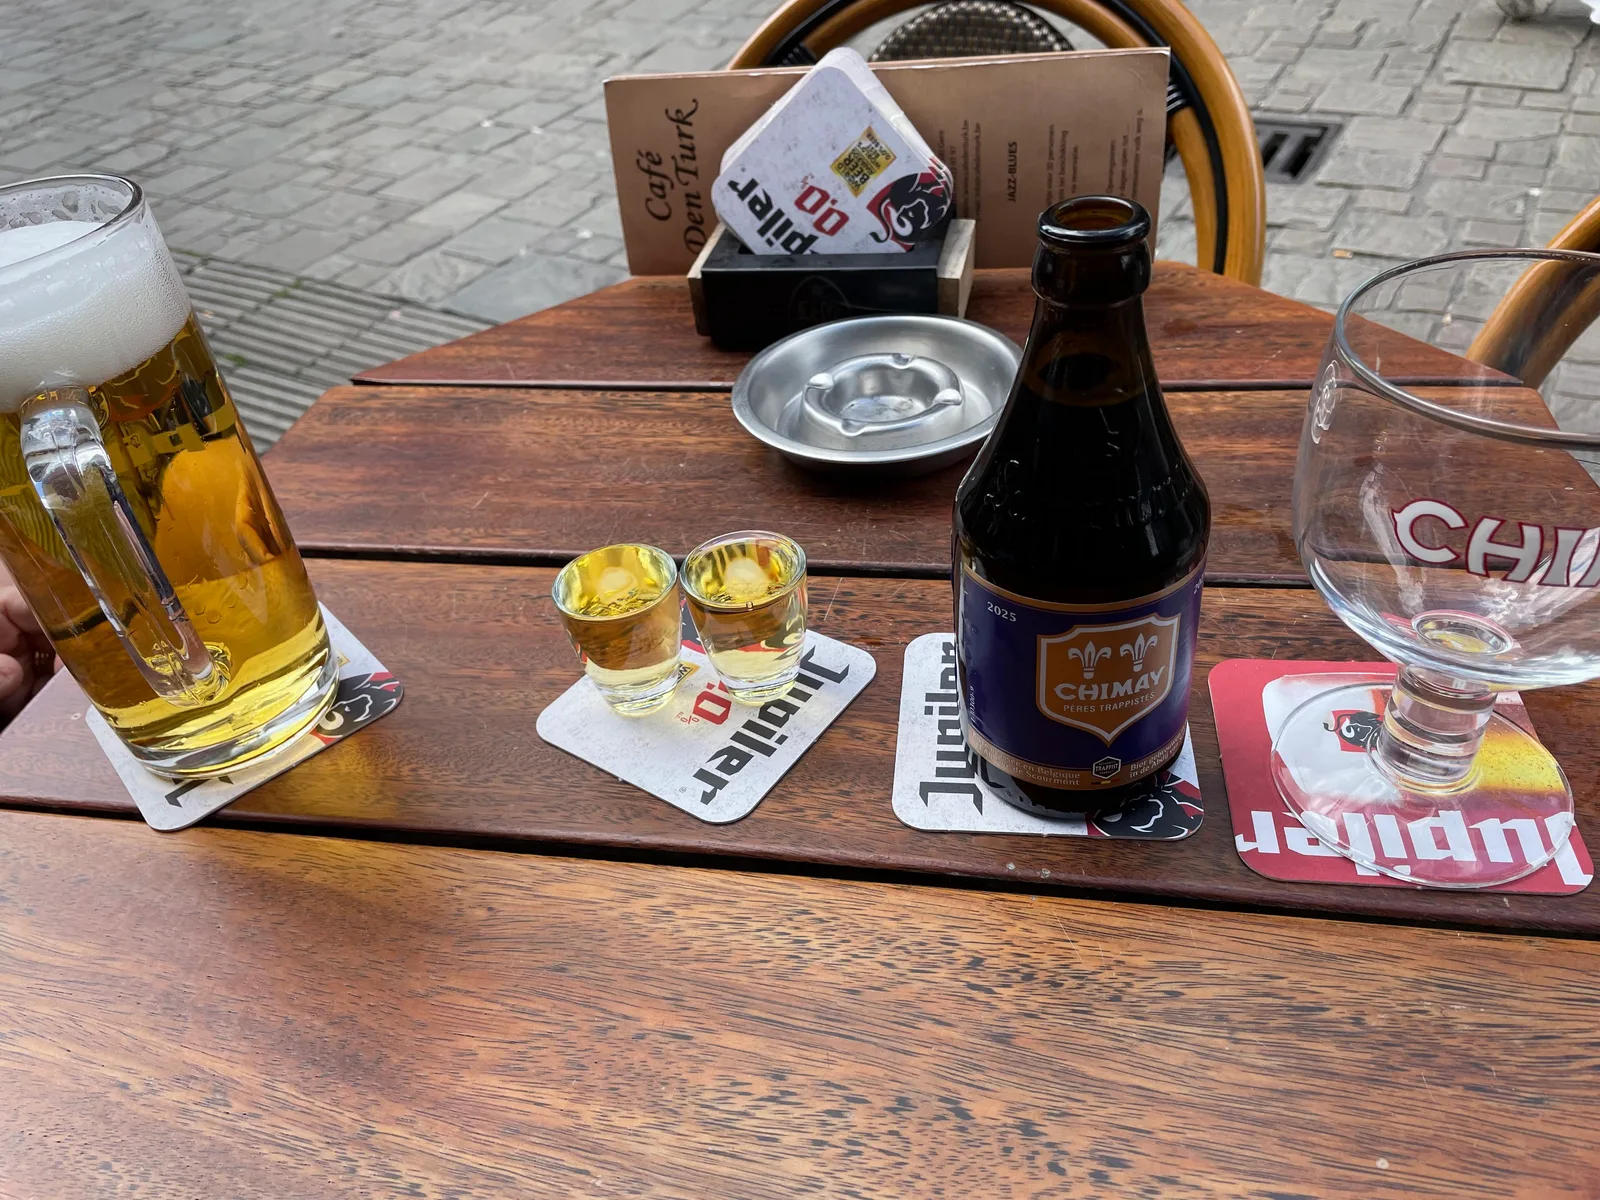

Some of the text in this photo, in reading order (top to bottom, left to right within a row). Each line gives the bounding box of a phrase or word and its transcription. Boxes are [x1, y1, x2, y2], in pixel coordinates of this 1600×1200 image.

[636, 149, 674, 222] Café
[665, 98, 708, 255] Den Turk
[843, 157, 870, 184] BEER
[1007, 141, 1018, 203] JAZZ-BLUES
[728, 178, 820, 255] piler
[1391, 498, 1600, 588] CHI
[987, 601, 1018, 622] 2025
[1053, 665, 1165, 701] CHIMAY
[1063, 691, 1156, 713] PÈRES TRAPPISTES
[692, 645, 850, 805] Jupiler
[1023, 763, 1034, 771] en
[1037, 765, 1081, 779] Belgique
[1026, 770, 1081, 786] Scourmont
[1129, 769, 1139, 778] in
[1140, 766, 1151, 774] de
[1130, 759, 1147, 771] Bier
[1235, 810, 1594, 886] Jupiler
